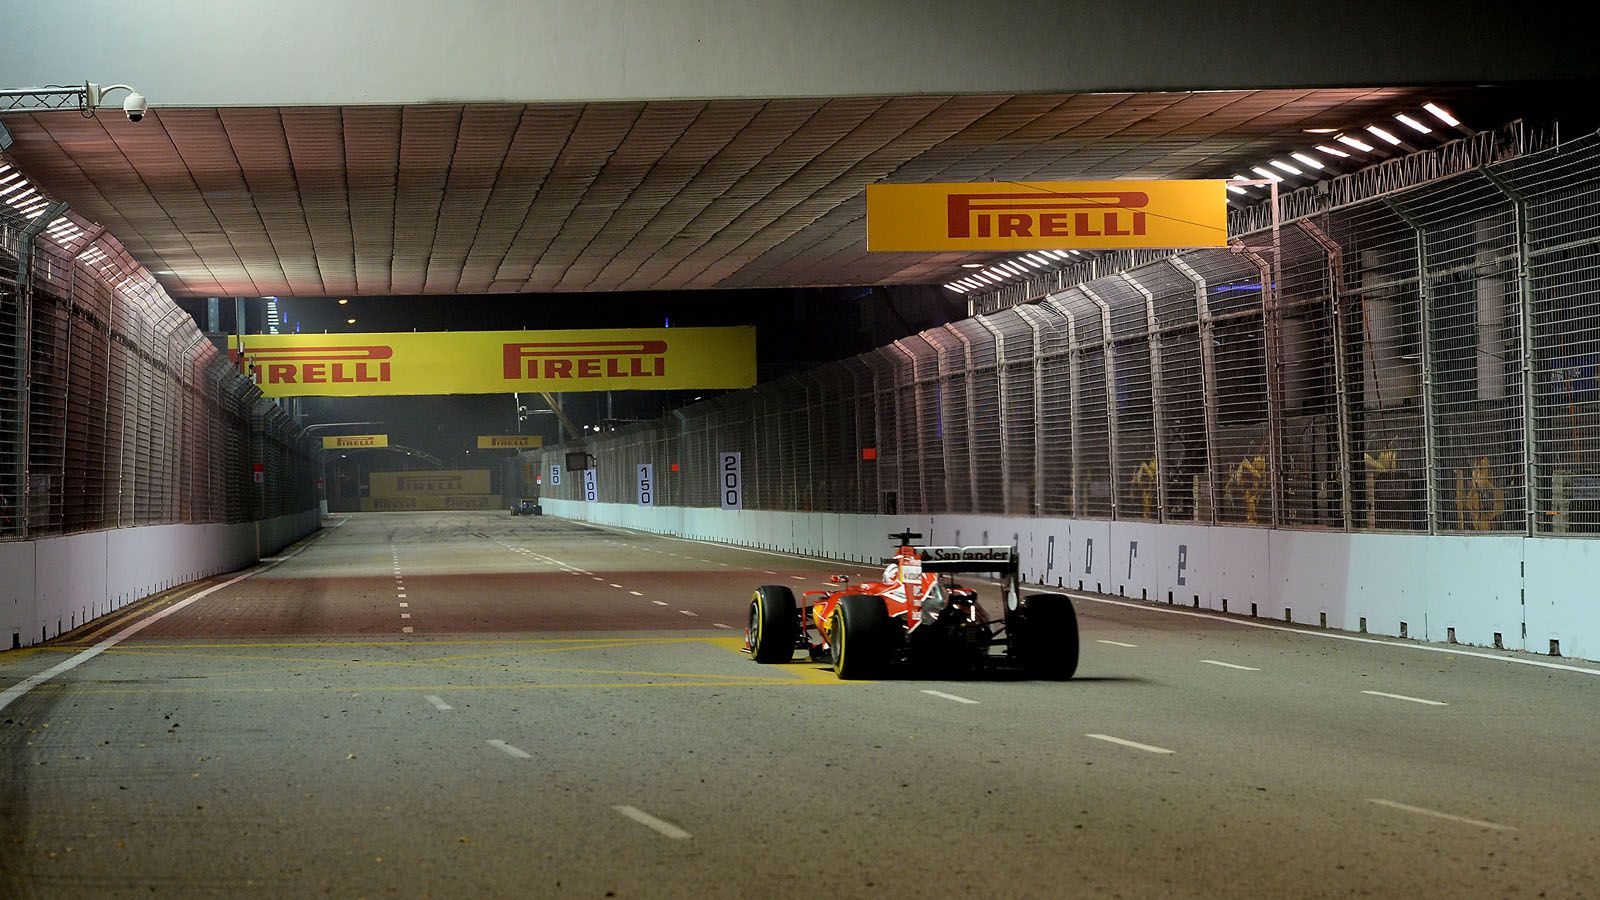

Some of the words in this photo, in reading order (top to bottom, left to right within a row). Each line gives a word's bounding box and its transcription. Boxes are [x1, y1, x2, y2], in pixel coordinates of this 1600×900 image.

[948, 191, 1149, 238] PIRELLI
[503, 341, 667, 380] PIRELLI
[336, 436, 374, 446] PIRELLI
[552, 467, 559, 484] 50
[586, 471, 595, 501] 100
[640, 467, 651, 503] 150
[724, 456, 738, 505] 200
[933, 548, 1008, 561] Santander
